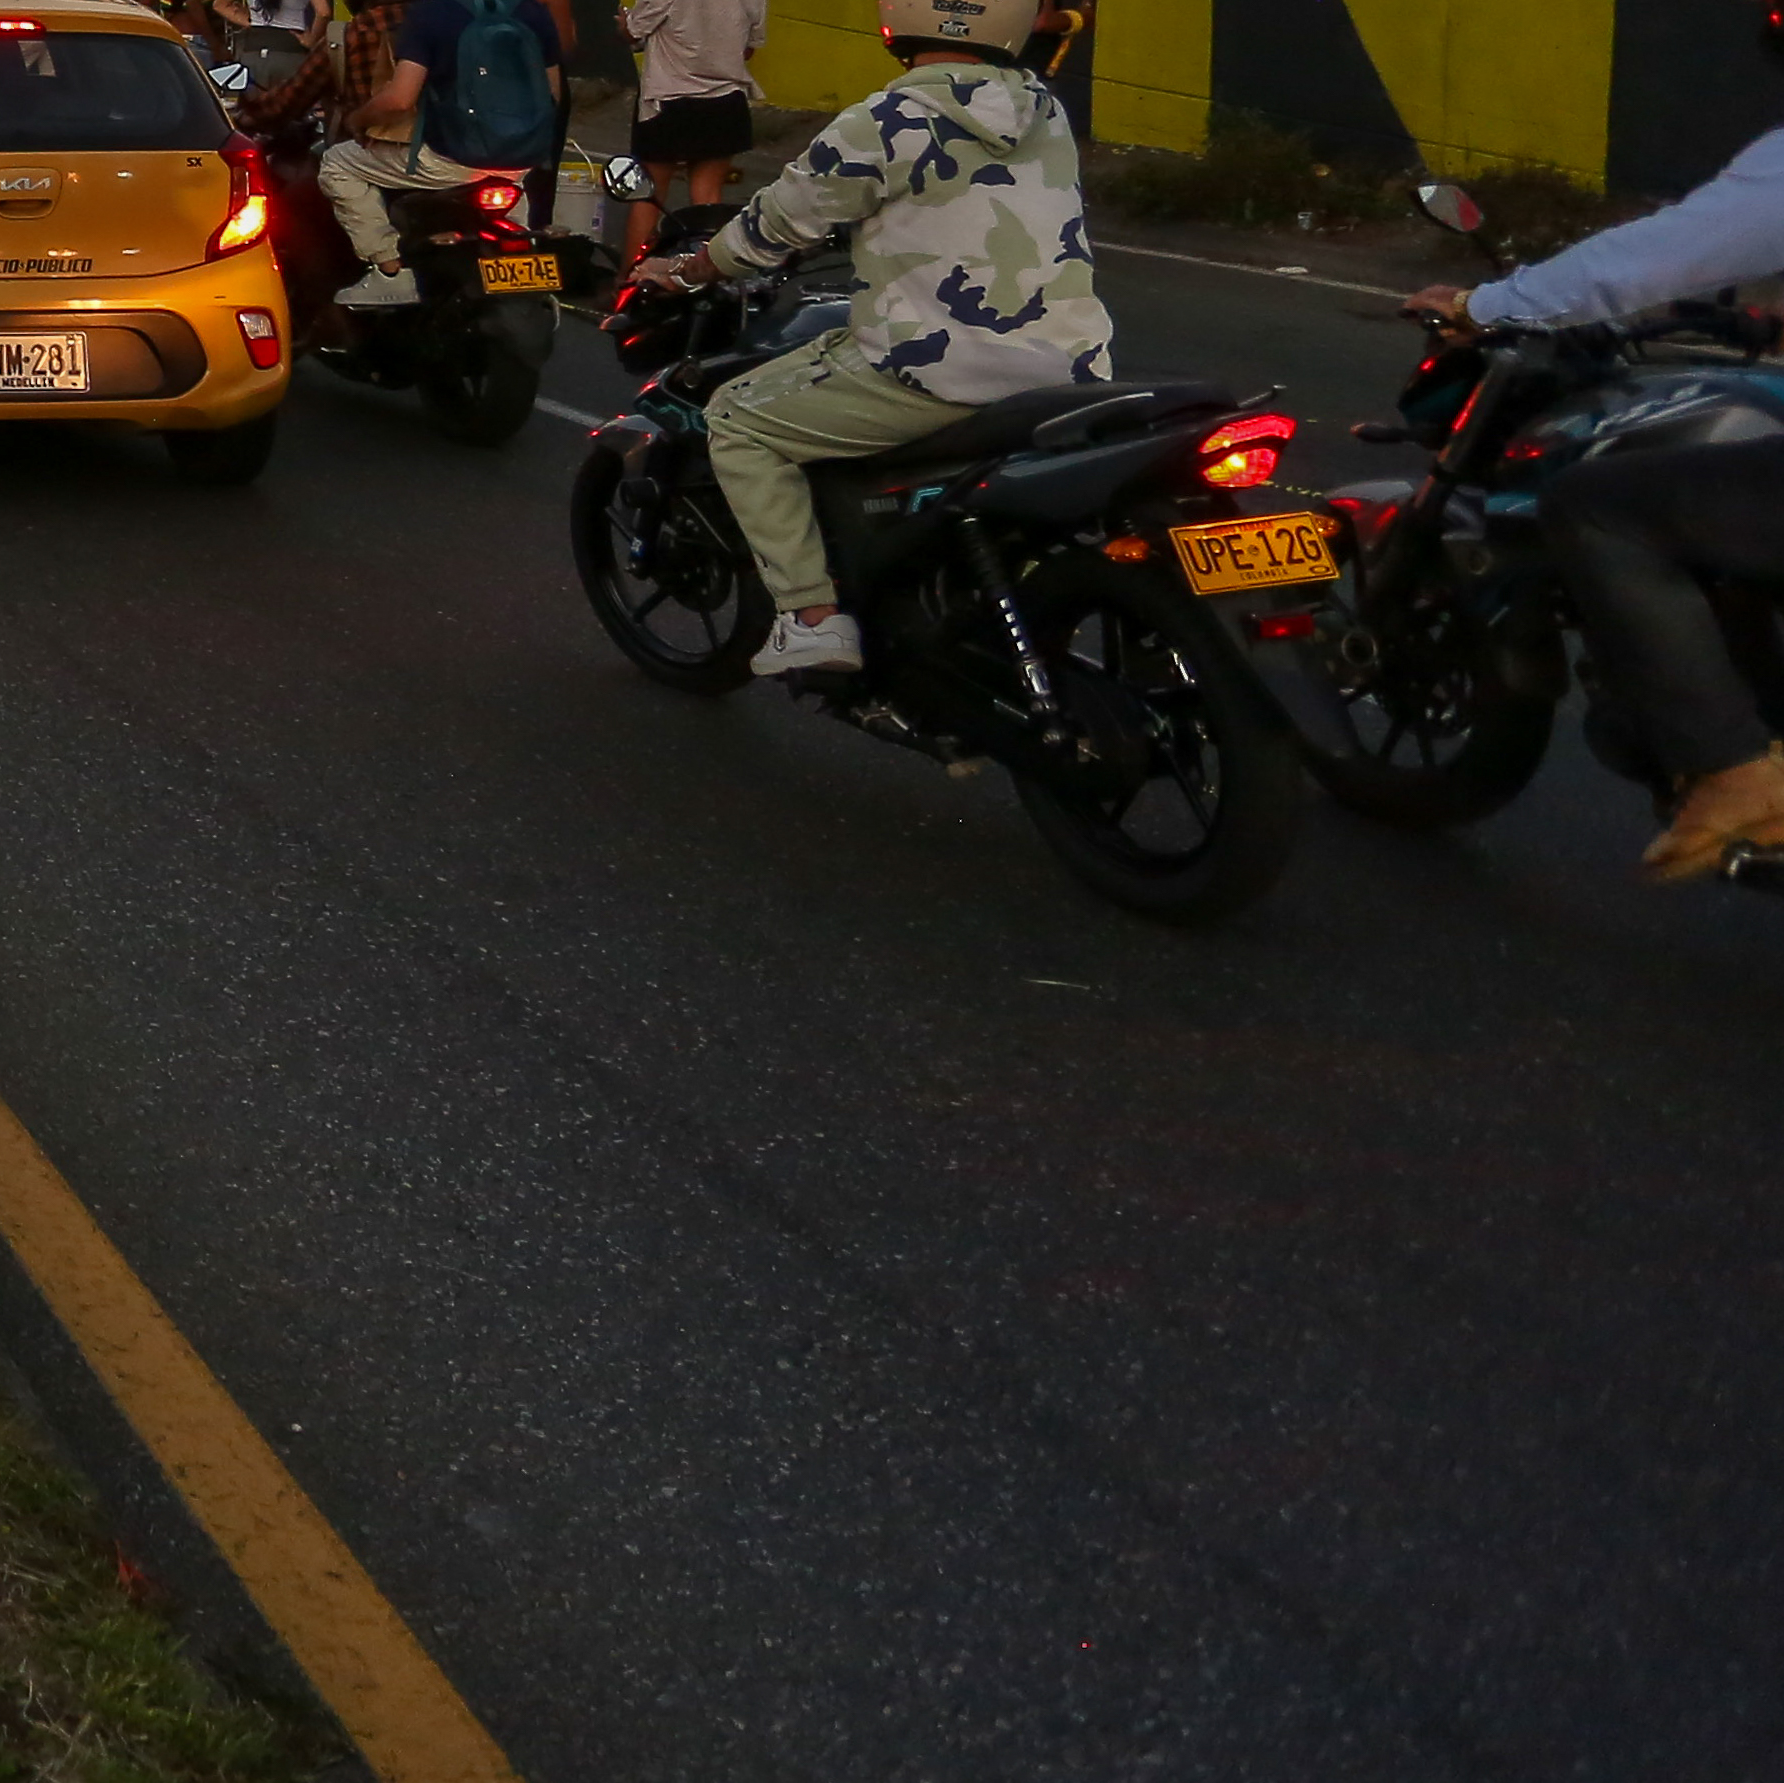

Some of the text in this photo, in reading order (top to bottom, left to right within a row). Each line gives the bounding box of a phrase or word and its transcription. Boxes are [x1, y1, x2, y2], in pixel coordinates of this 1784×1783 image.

[187, 157, 202, 167] SX
[0, 177, 51, 191] KIA
[2, 378, 55, 388] MEDELLIN
